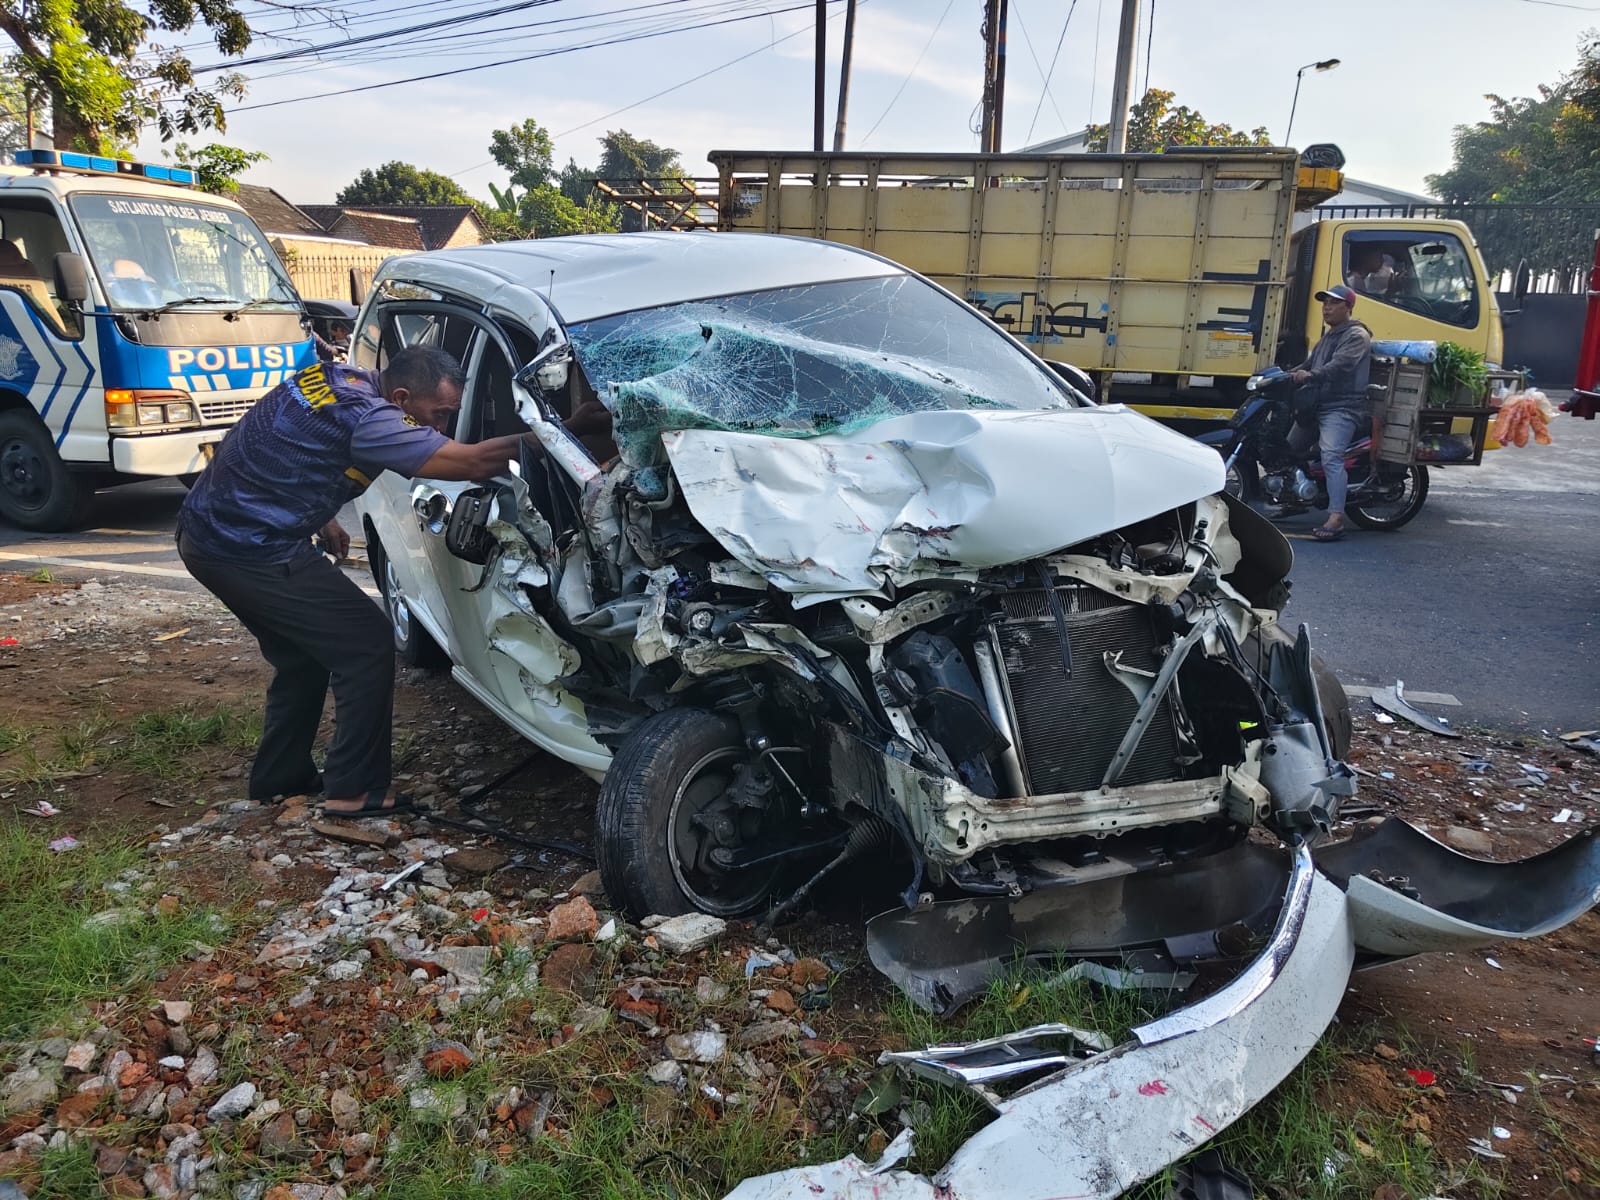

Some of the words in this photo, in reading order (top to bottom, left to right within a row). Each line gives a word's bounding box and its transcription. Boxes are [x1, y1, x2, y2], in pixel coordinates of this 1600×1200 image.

[108, 199, 165, 217] SATLANTAS
[163, 204, 200, 220] POLRES
[168, 345, 295, 373] POLISI
